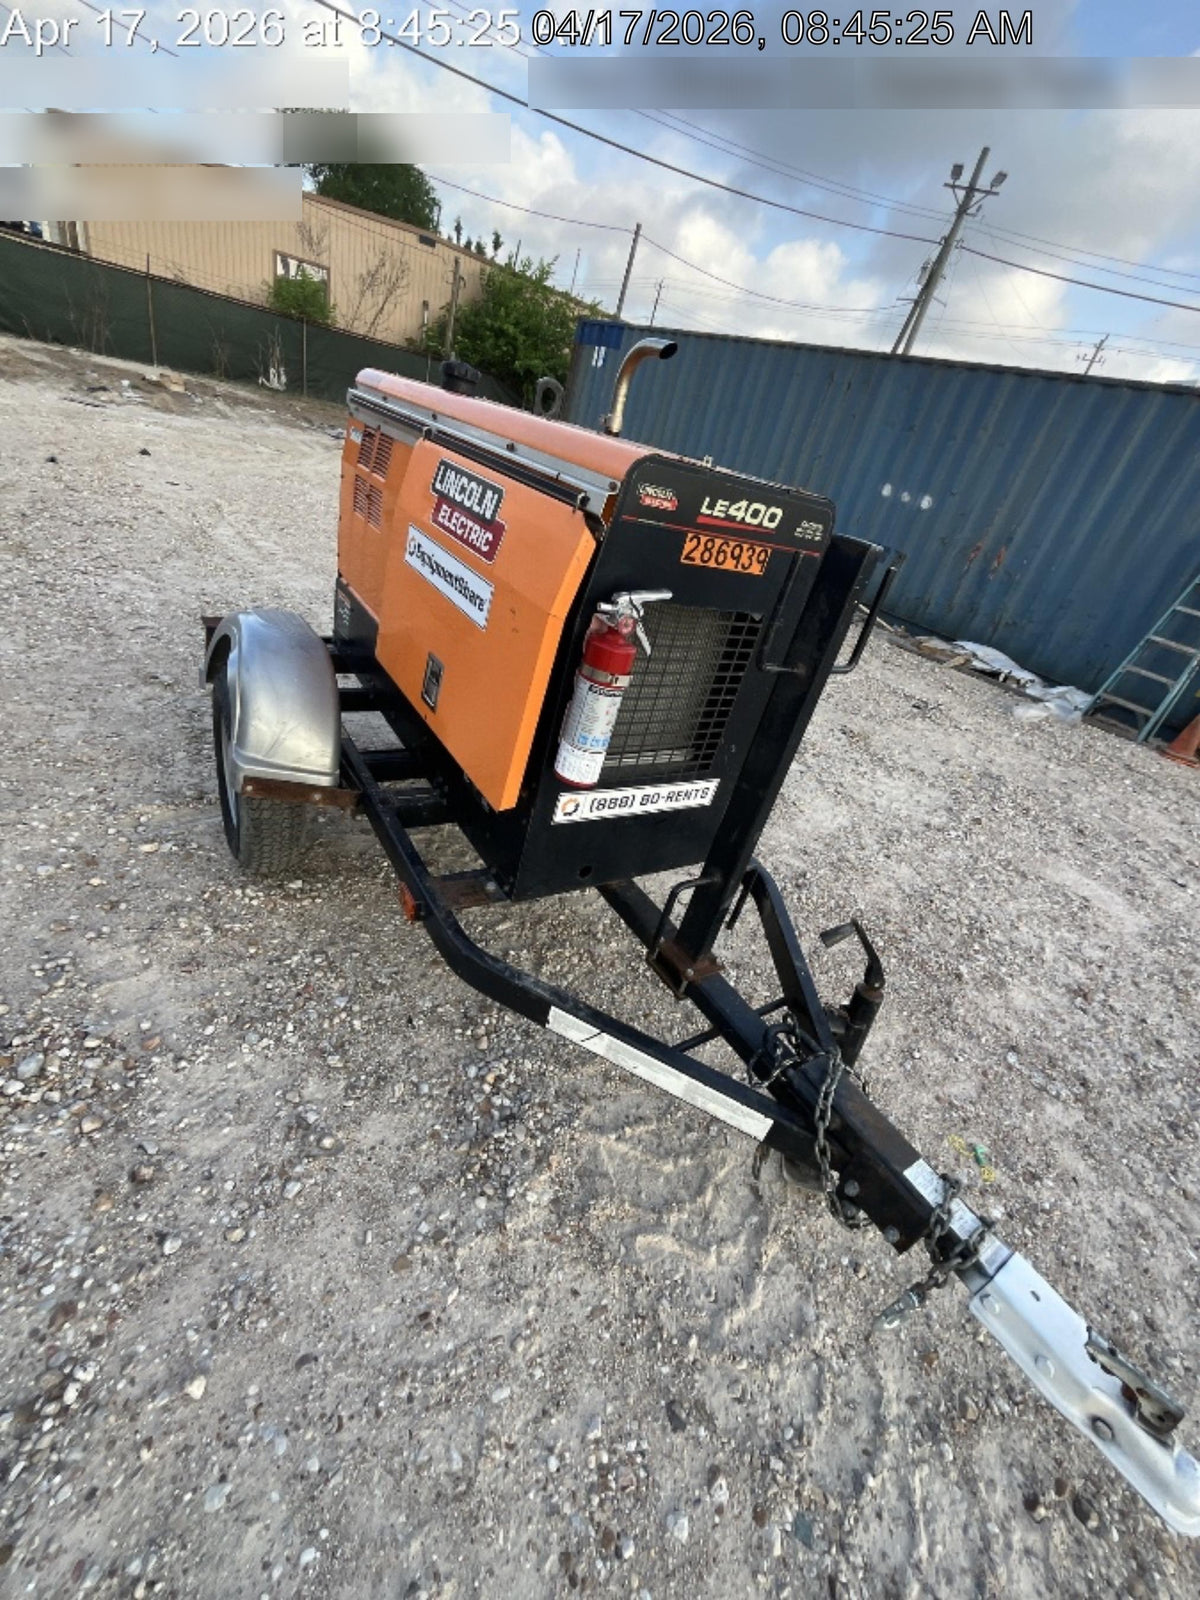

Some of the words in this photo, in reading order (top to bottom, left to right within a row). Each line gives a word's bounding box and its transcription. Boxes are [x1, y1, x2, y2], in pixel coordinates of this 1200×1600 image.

[435, 465, 497, 520] LINCOLN
[700, 496, 783, 529] LE400
[437, 504, 493, 553] ELECTRIC
[683, 535, 768, 572] 286939
[415, 542, 487, 612] EquipmentShare
[591, 794, 635, 812] (888)
